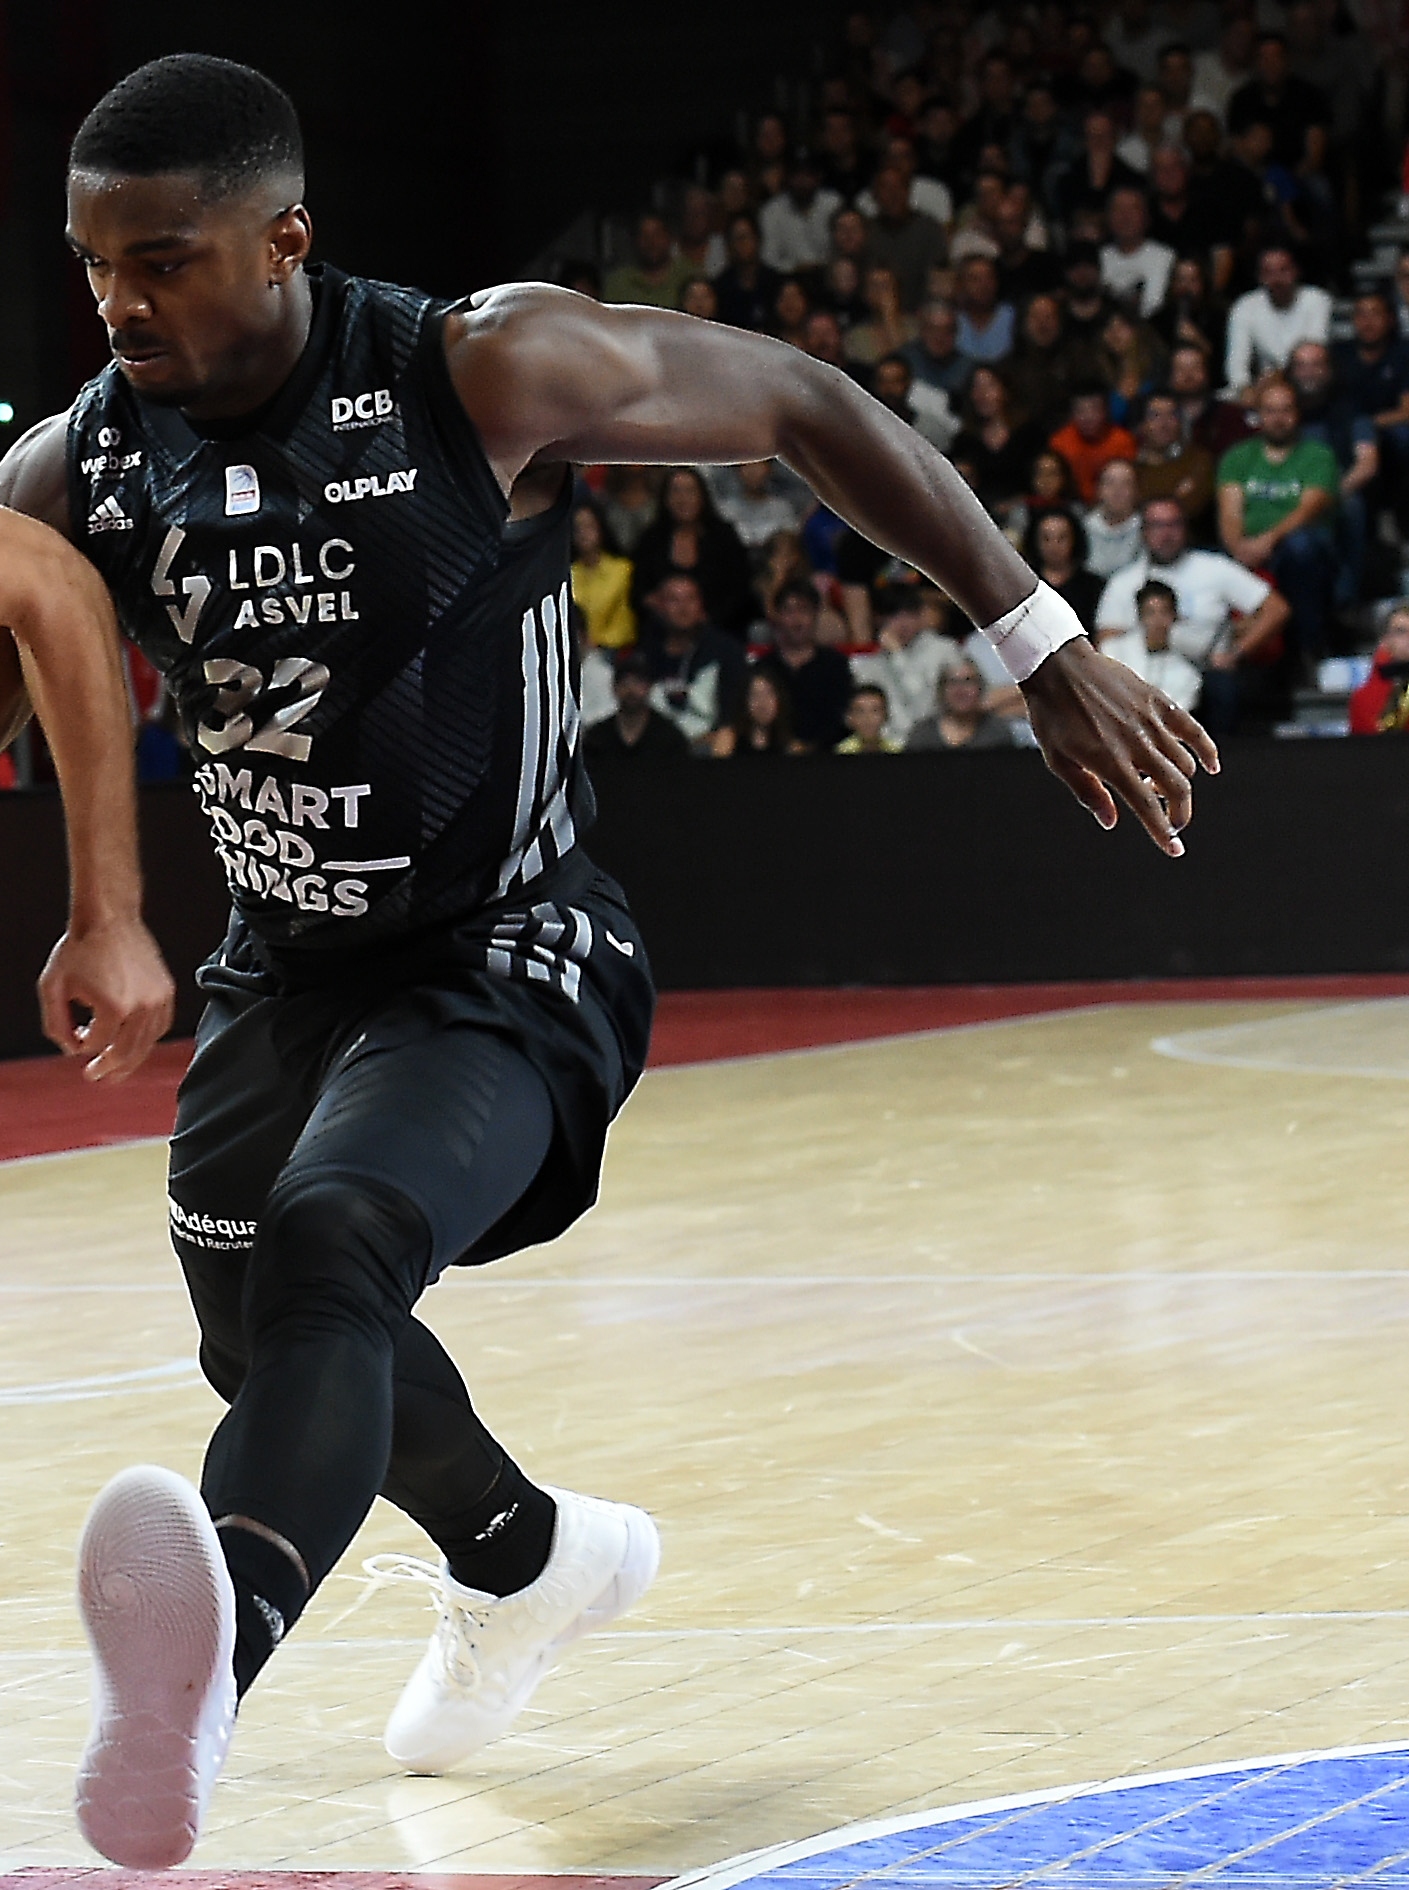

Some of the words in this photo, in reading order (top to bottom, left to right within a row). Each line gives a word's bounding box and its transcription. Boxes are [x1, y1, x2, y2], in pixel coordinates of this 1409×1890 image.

[332, 389, 393, 423] DCB
[81, 450, 142, 475] webex
[324, 468, 418, 503] OLPLAY
[228, 538, 356, 590] LDLC
[233, 591, 360, 630] ASVEL
[197, 657, 331, 763] 32
[194, 763, 371, 829] SMART
